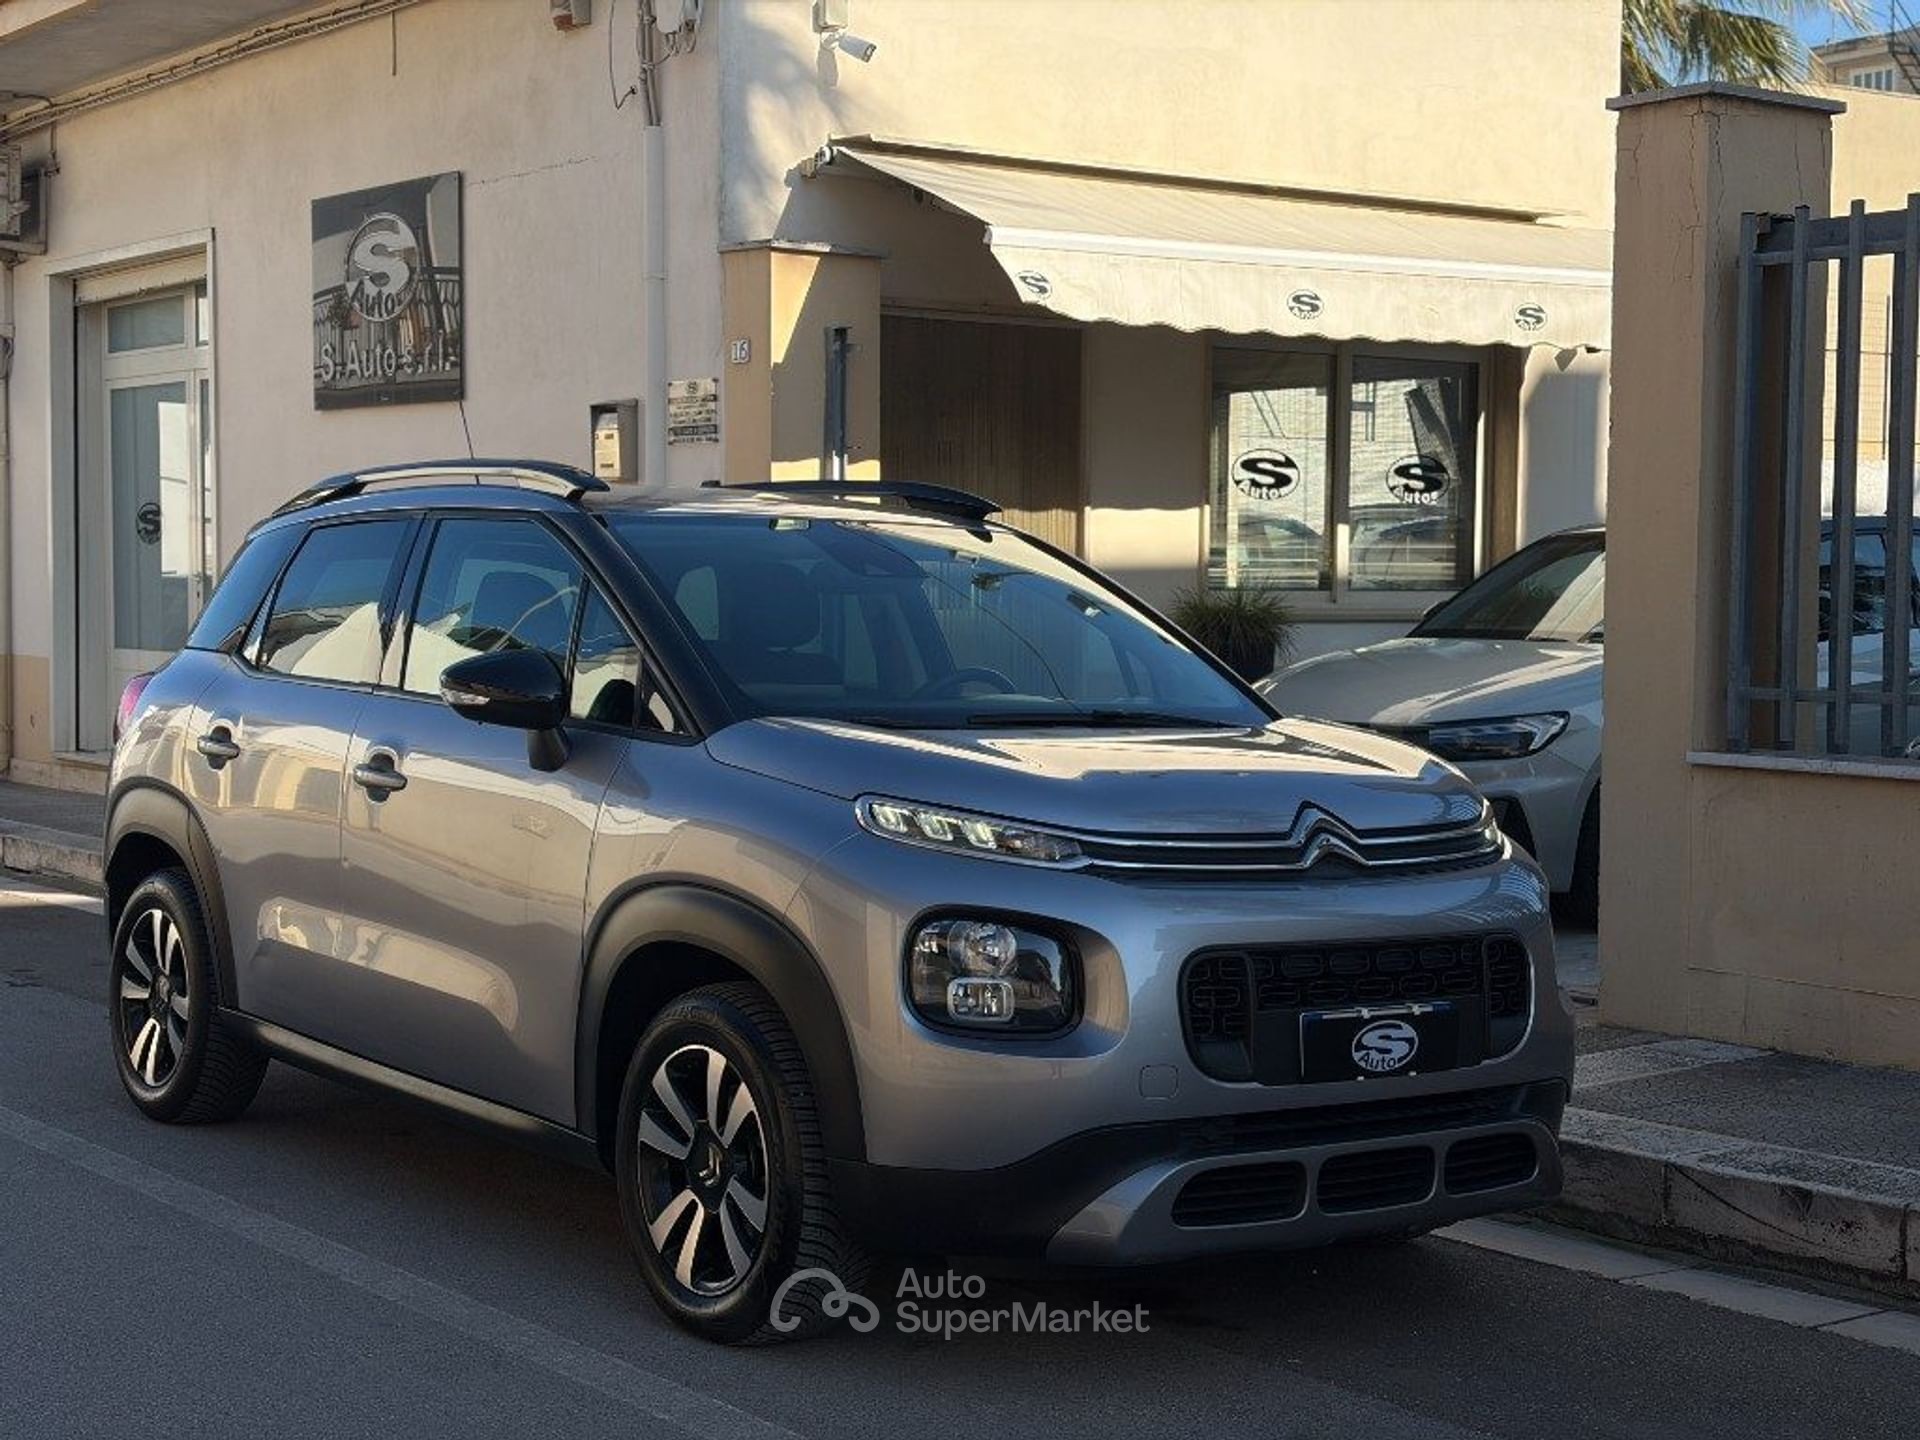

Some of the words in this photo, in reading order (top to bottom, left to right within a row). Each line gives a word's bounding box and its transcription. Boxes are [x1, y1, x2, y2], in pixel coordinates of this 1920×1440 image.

[346, 221, 417, 296] S
[350, 279, 396, 318] Auto
[1288, 292, 1321, 312] S
[1514, 305, 1546, 325] S
[345, 339, 396, 378] Auto
[732, 341, 749, 361] 16
[1234, 454, 1298, 490] S
[1389, 457, 1448, 493] S
[1354, 1022, 1416, 1064] S
[1358, 1052, 1399, 1070] Auto
